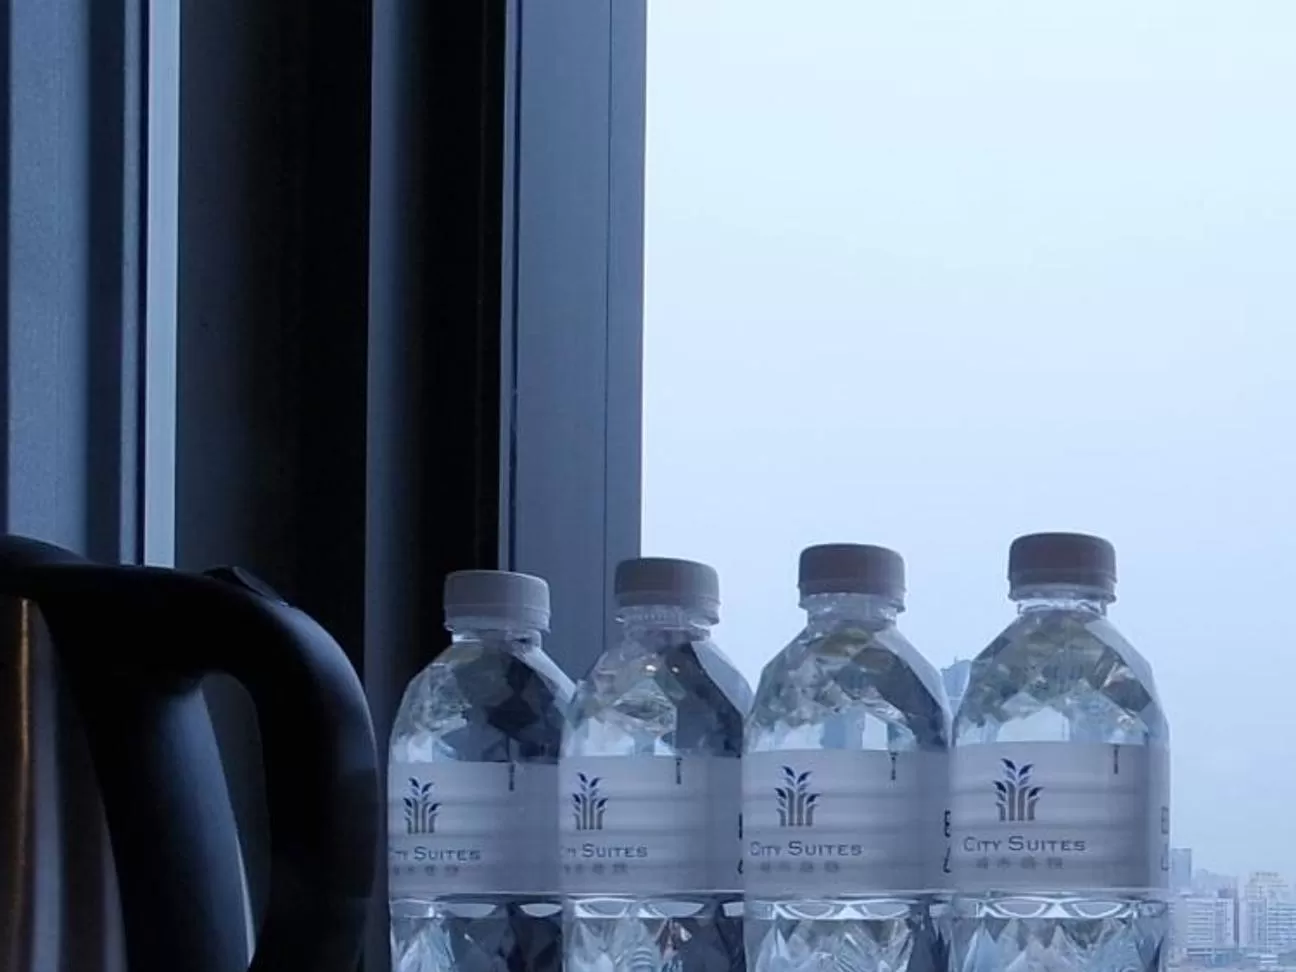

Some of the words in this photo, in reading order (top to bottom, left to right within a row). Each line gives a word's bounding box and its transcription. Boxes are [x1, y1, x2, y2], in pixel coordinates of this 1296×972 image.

[787, 840, 862, 856] SUITES
[963, 836, 1002, 852] CITY
[1008, 835, 1086, 852] SUITES
